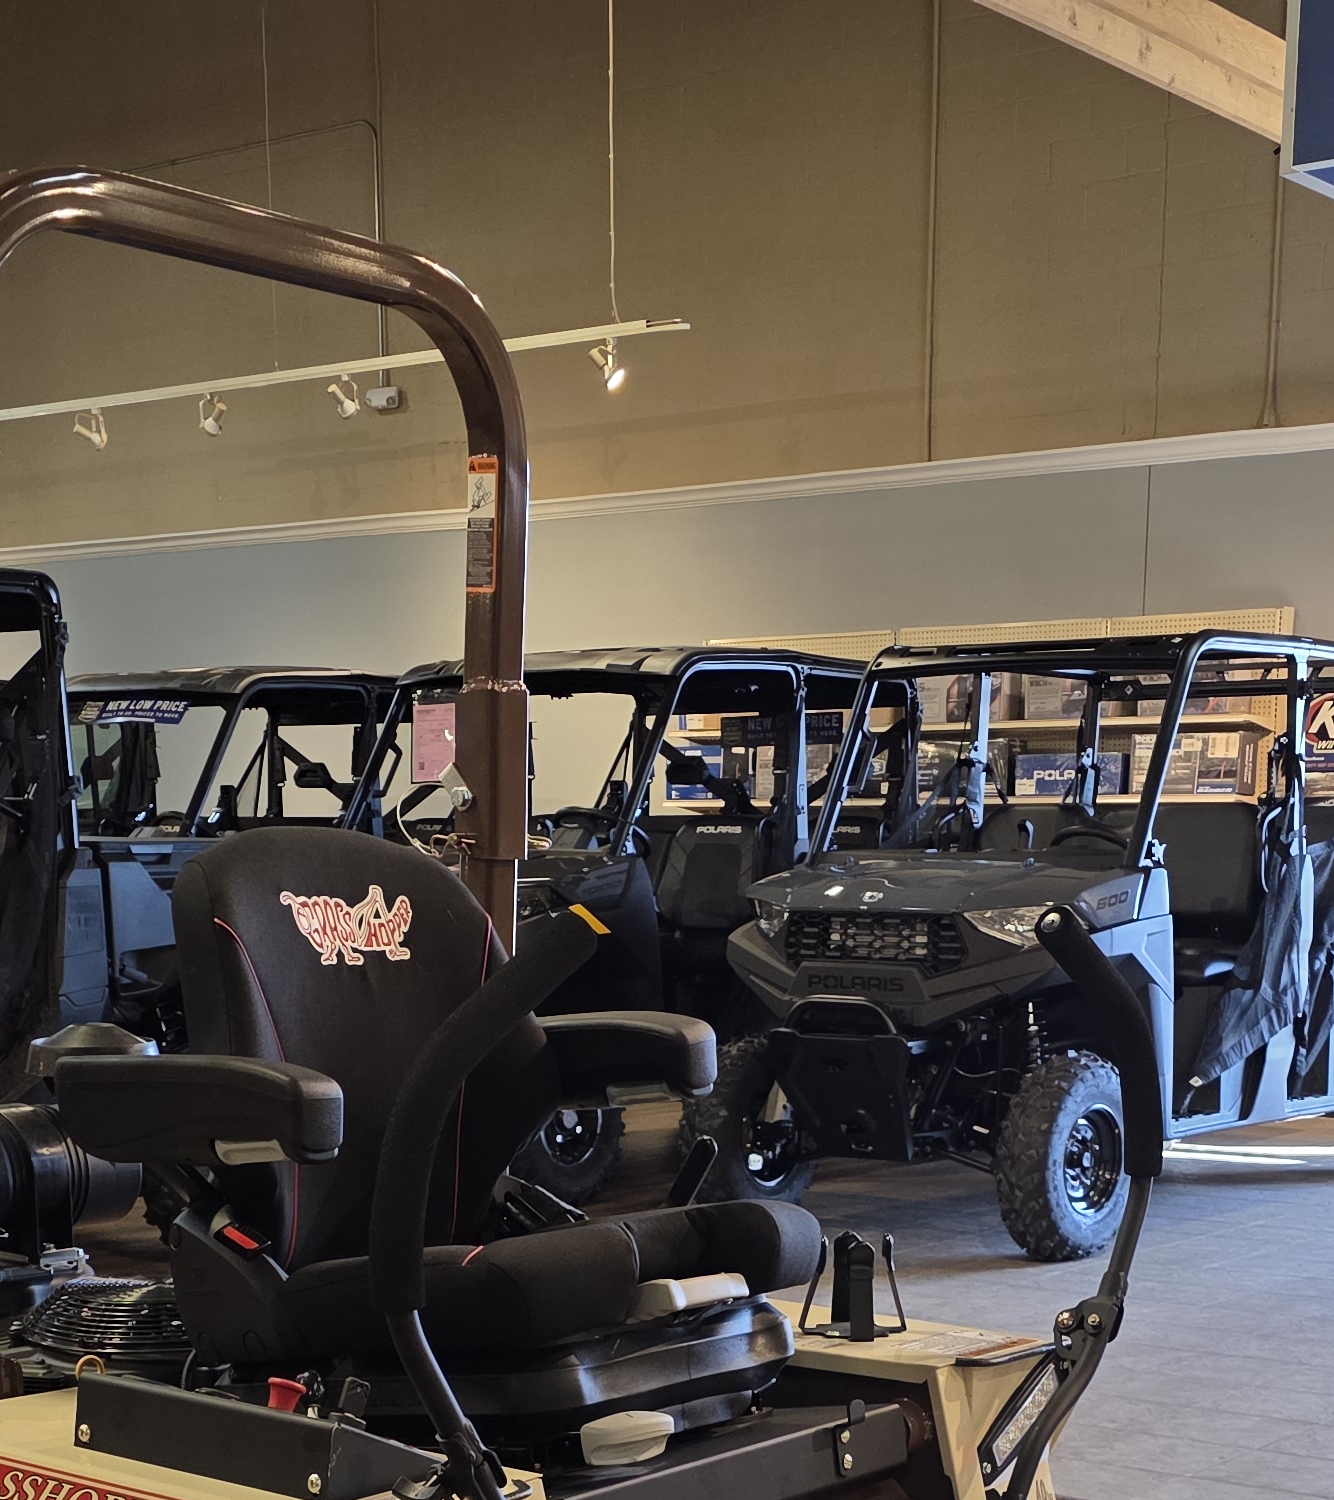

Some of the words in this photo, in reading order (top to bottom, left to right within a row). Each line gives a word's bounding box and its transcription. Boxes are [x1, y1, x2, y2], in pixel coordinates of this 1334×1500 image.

[106, 700, 129, 711] NEW
[129, 700, 154, 710] LOW
[153, 701, 187, 712] PRICE
[747, 716, 772, 730] NEW
[1033, 769, 1076, 781] POLA
[696, 826, 742, 834] POLARIS
[1095, 889, 1130, 911] 600
[807, 973, 905, 992] POLARIS
